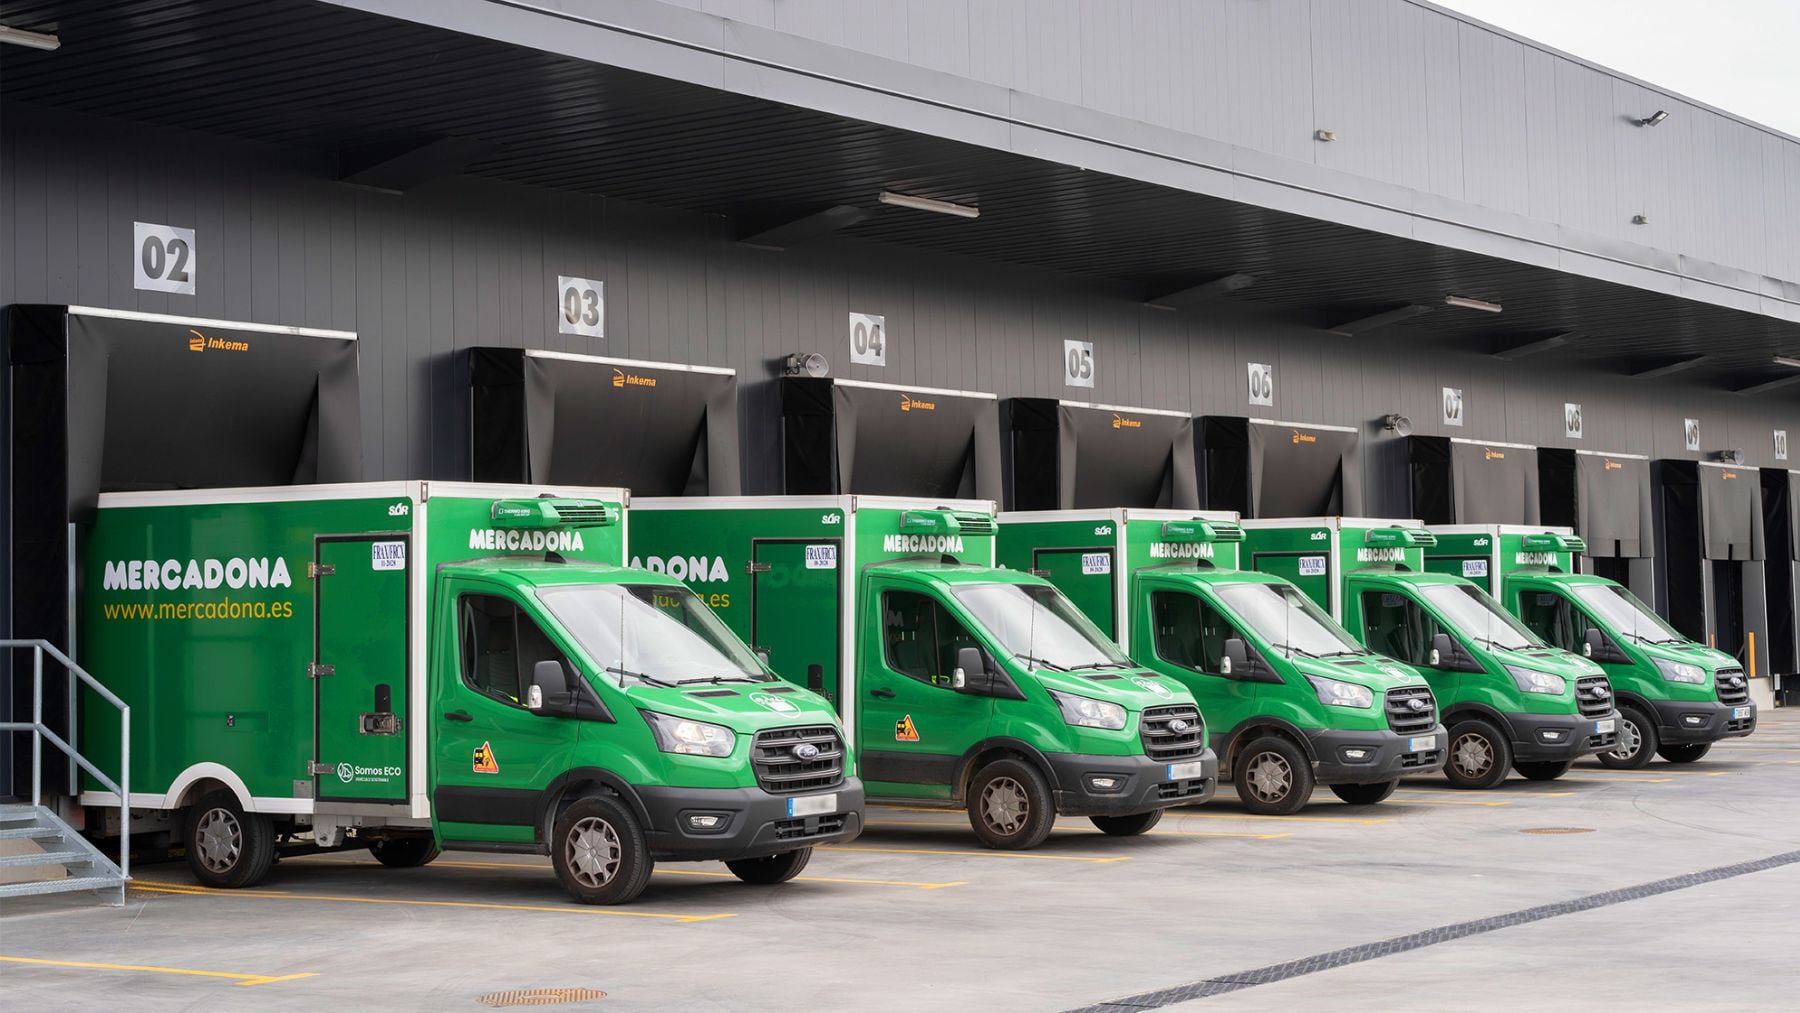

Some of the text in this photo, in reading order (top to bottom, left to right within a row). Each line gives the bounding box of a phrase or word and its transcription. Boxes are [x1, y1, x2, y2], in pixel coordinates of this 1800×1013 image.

[142, 235, 189, 282] 02
[564, 287, 599, 326] 03
[207, 337, 249, 352] Inkema
[854, 322, 882, 356] 04
[1068, 348, 1091, 379] 05
[626, 374, 657, 387] Inkema
[1251, 370, 1270, 399] 06
[1445, 394, 1461, 419] 07
[1567, 409, 1580, 432] 08
[1687, 424, 1698, 445] 09
[1776, 435, 1786, 455] 10
[469, 528, 584, 551] MERCADONA
[884, 534, 964, 553] MERCADONA
[1150, 542, 1214, 559] MERCADONA
[1357, 547, 1405, 562] MERCADONA
[1515, 551, 1558, 565] MERCADONA
[103, 557, 292, 591] MERCADONA
[104, 597, 293, 620] www.mercadona.es
[355, 765, 401, 776] Somos ECO
